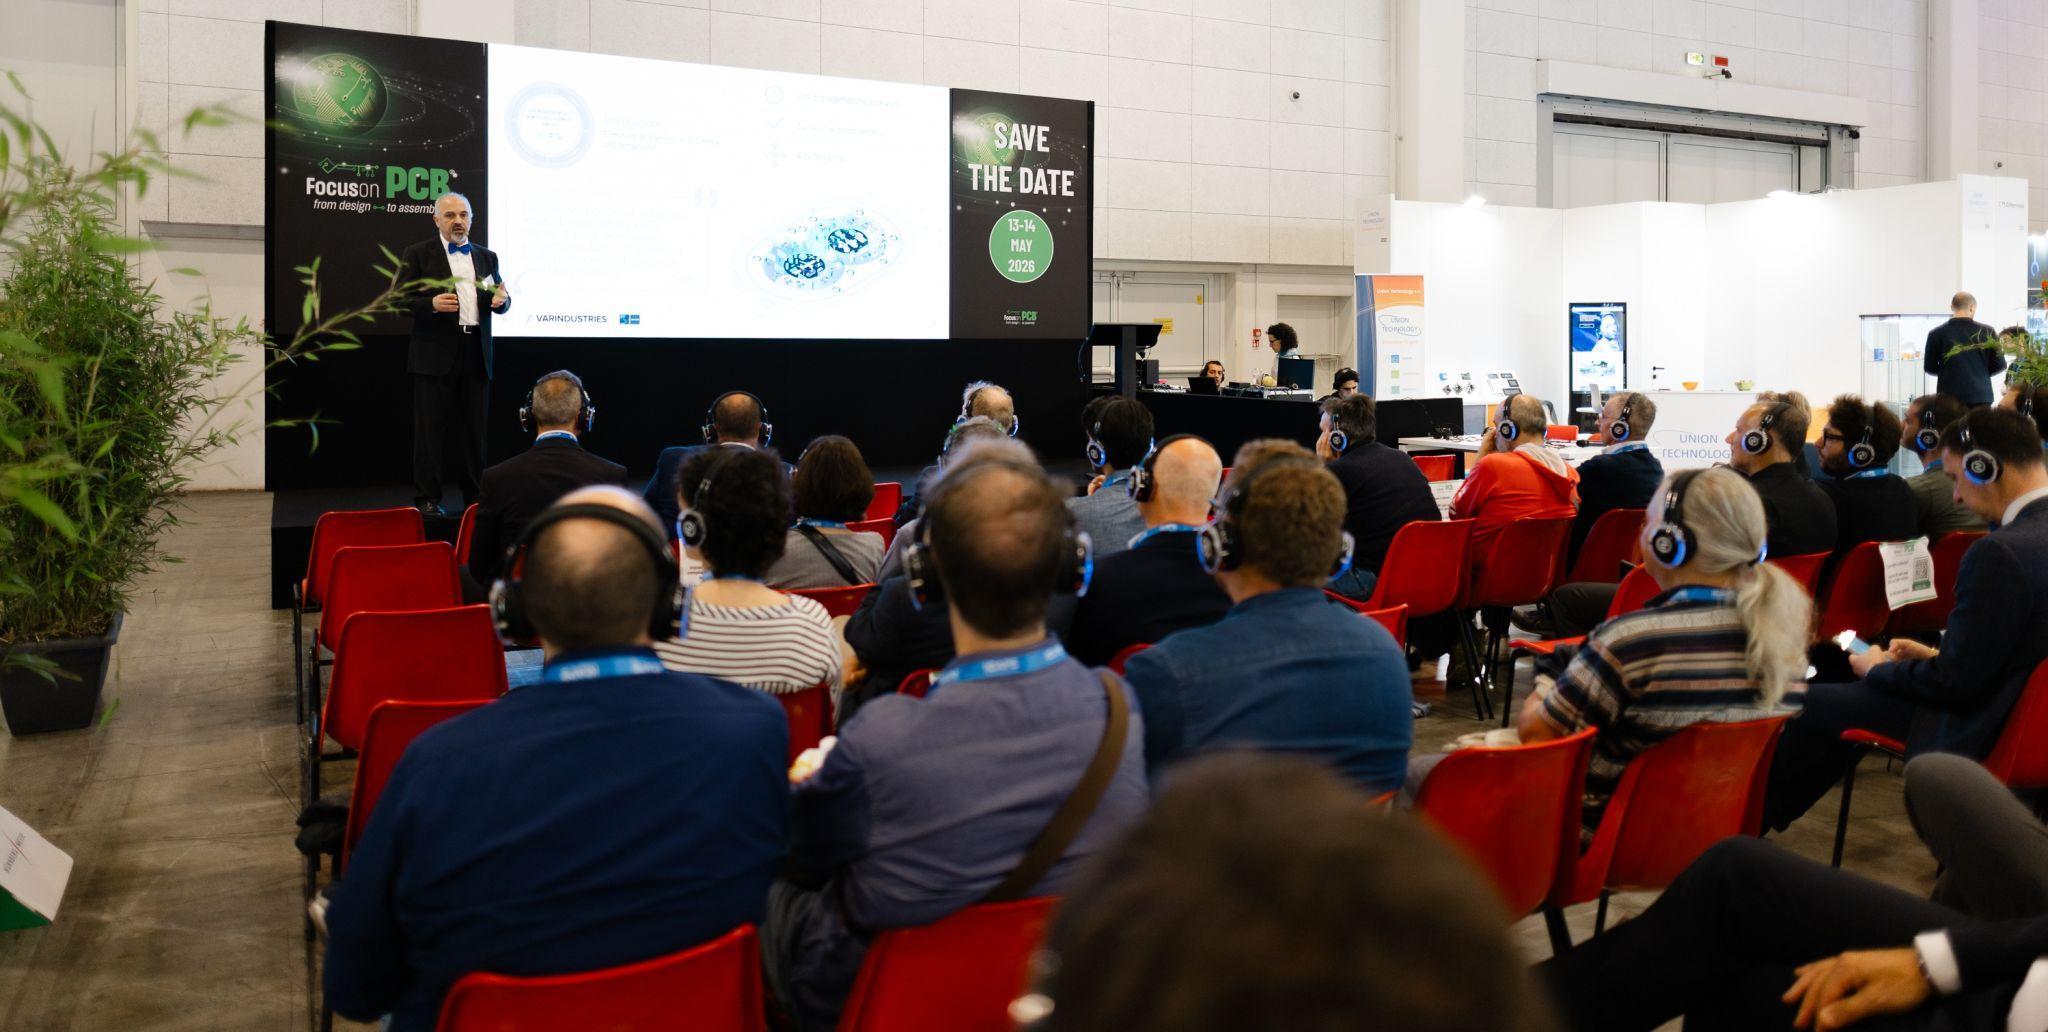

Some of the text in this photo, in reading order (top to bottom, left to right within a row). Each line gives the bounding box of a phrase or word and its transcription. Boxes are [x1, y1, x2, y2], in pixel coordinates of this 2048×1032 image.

[994, 122, 1050, 153] SAVE
[386, 165, 450, 201] PCB
[968, 163, 1075, 197] THE DATE
[313, 199, 436, 214] from design to assemb
[1008, 218, 1036, 233] 13-14
[1010, 239, 1032, 253] MAY
[1008, 259, 1035, 273] 2026
[536, 314, 608, 323] VARINDUSTRIES
[1680, 434, 1718, 444] UNION
[1662, 448, 1730, 459] TECHNOLOG
